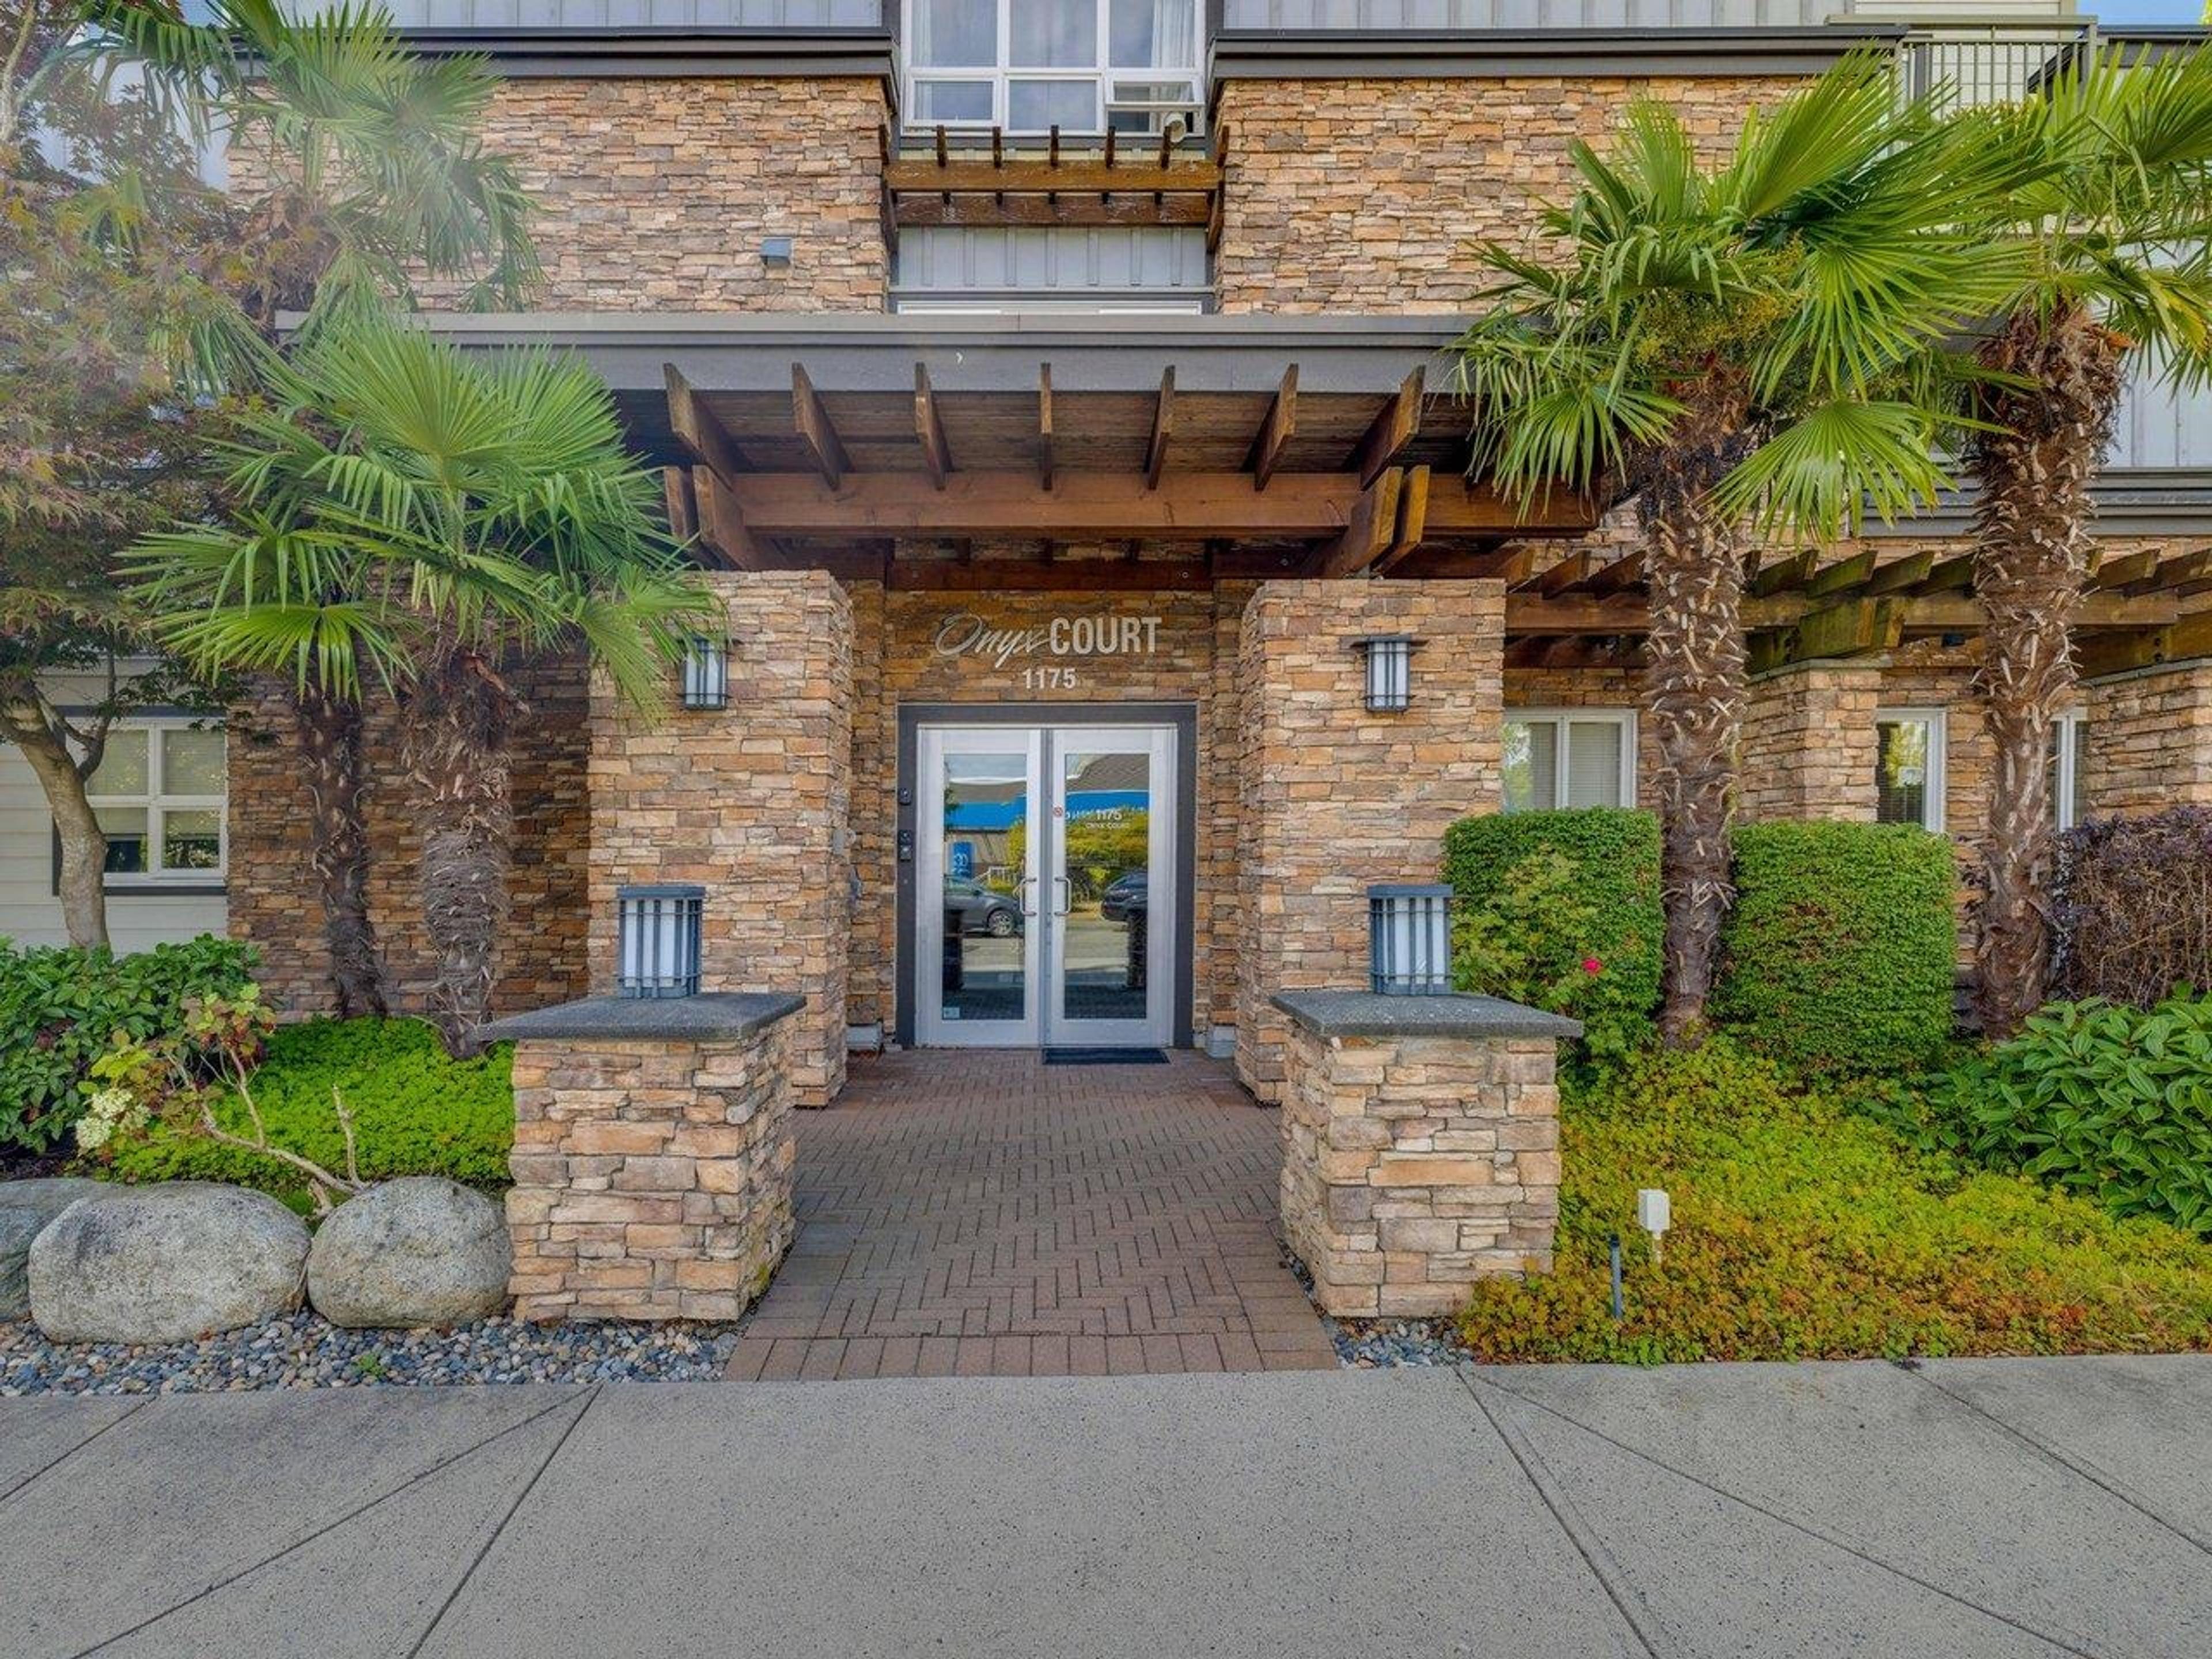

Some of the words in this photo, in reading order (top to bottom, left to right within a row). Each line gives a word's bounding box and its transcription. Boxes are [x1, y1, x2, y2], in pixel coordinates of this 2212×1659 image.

[935, 613, 1050, 668] Onyx
[1051, 617, 1162, 654] COURT
[1022, 668, 1077, 689] 1175
[1096, 808, 1122, 820] 1175
